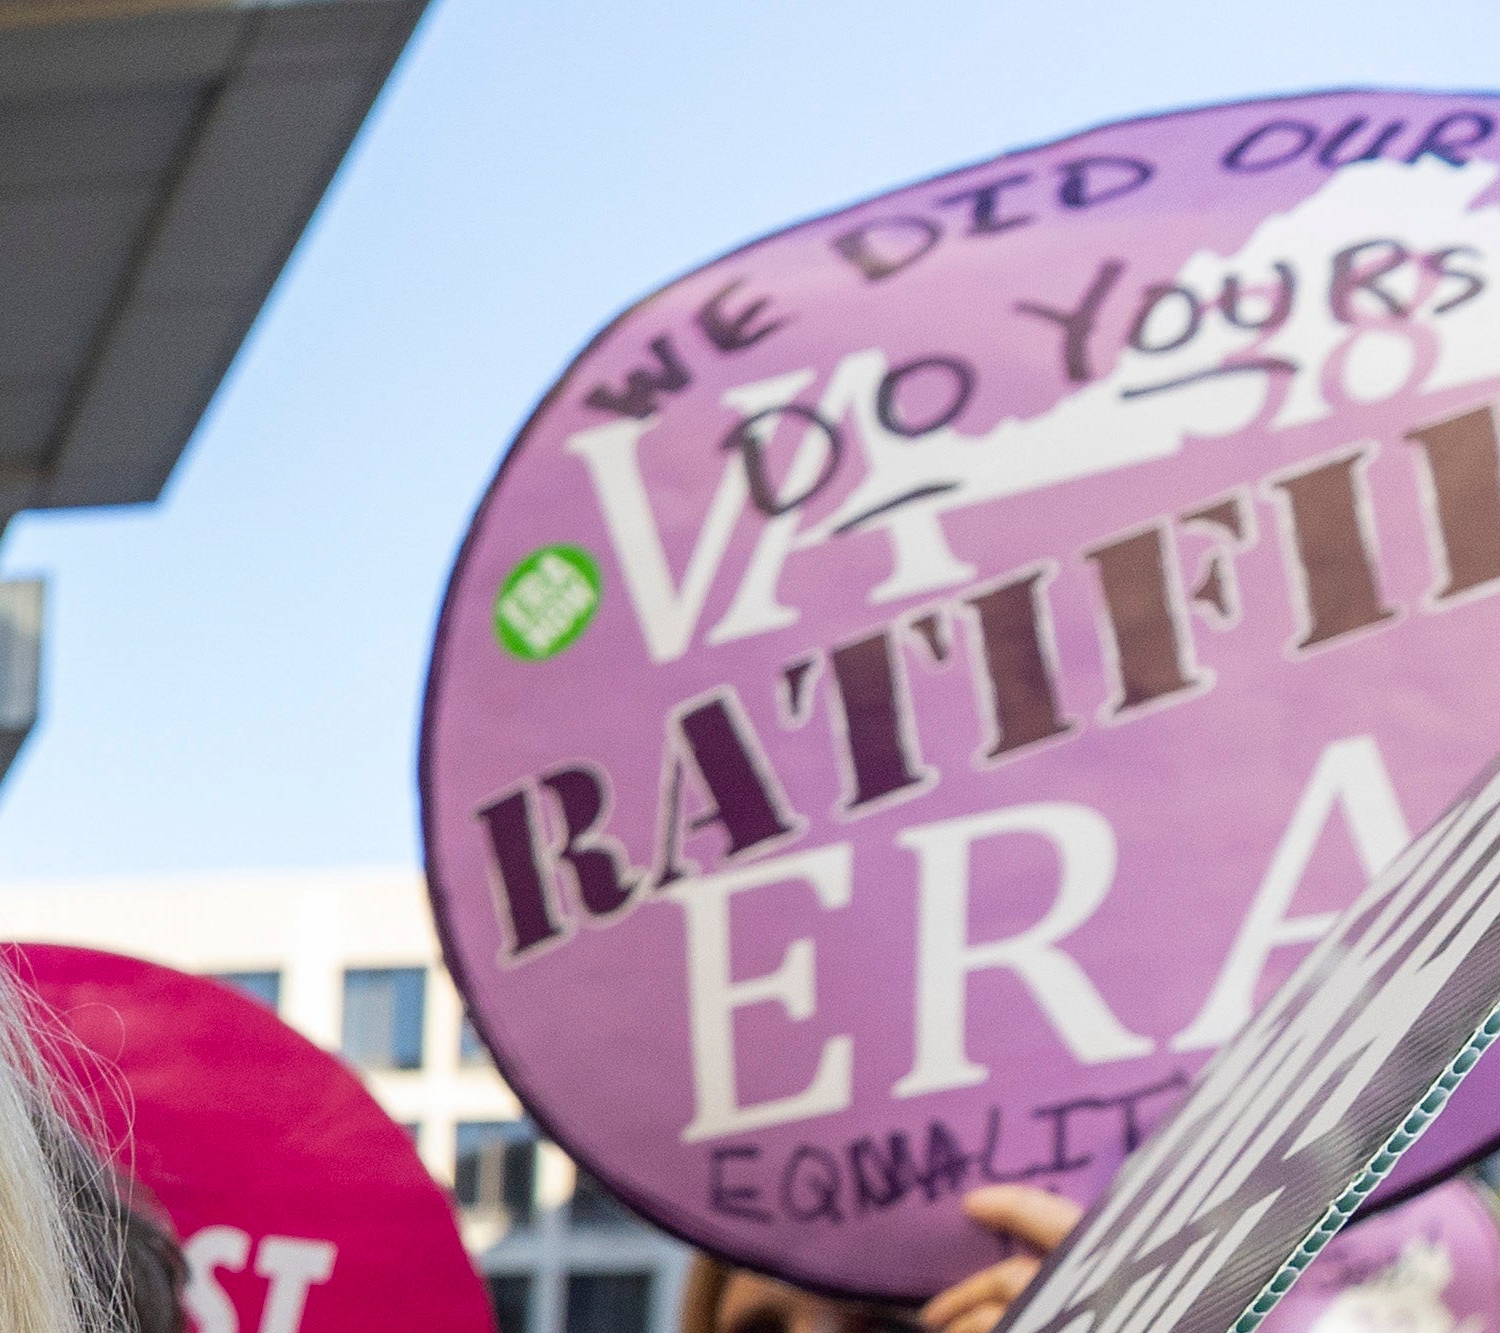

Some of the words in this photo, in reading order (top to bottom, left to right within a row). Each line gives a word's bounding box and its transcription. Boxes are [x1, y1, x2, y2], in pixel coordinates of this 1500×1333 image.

[582, 276, 795, 421] WE
[830, 154, 1160, 285] DID
[1219, 108, 1496, 174] OUR
[718, 352, 980, 519] DO
[1010, 235, 1488, 386] YOURS
[562, 345, 978, 667] VA
[678, 734, 1415, 1142] ERA
[706, 1068, 1194, 1226] EQUALIT
